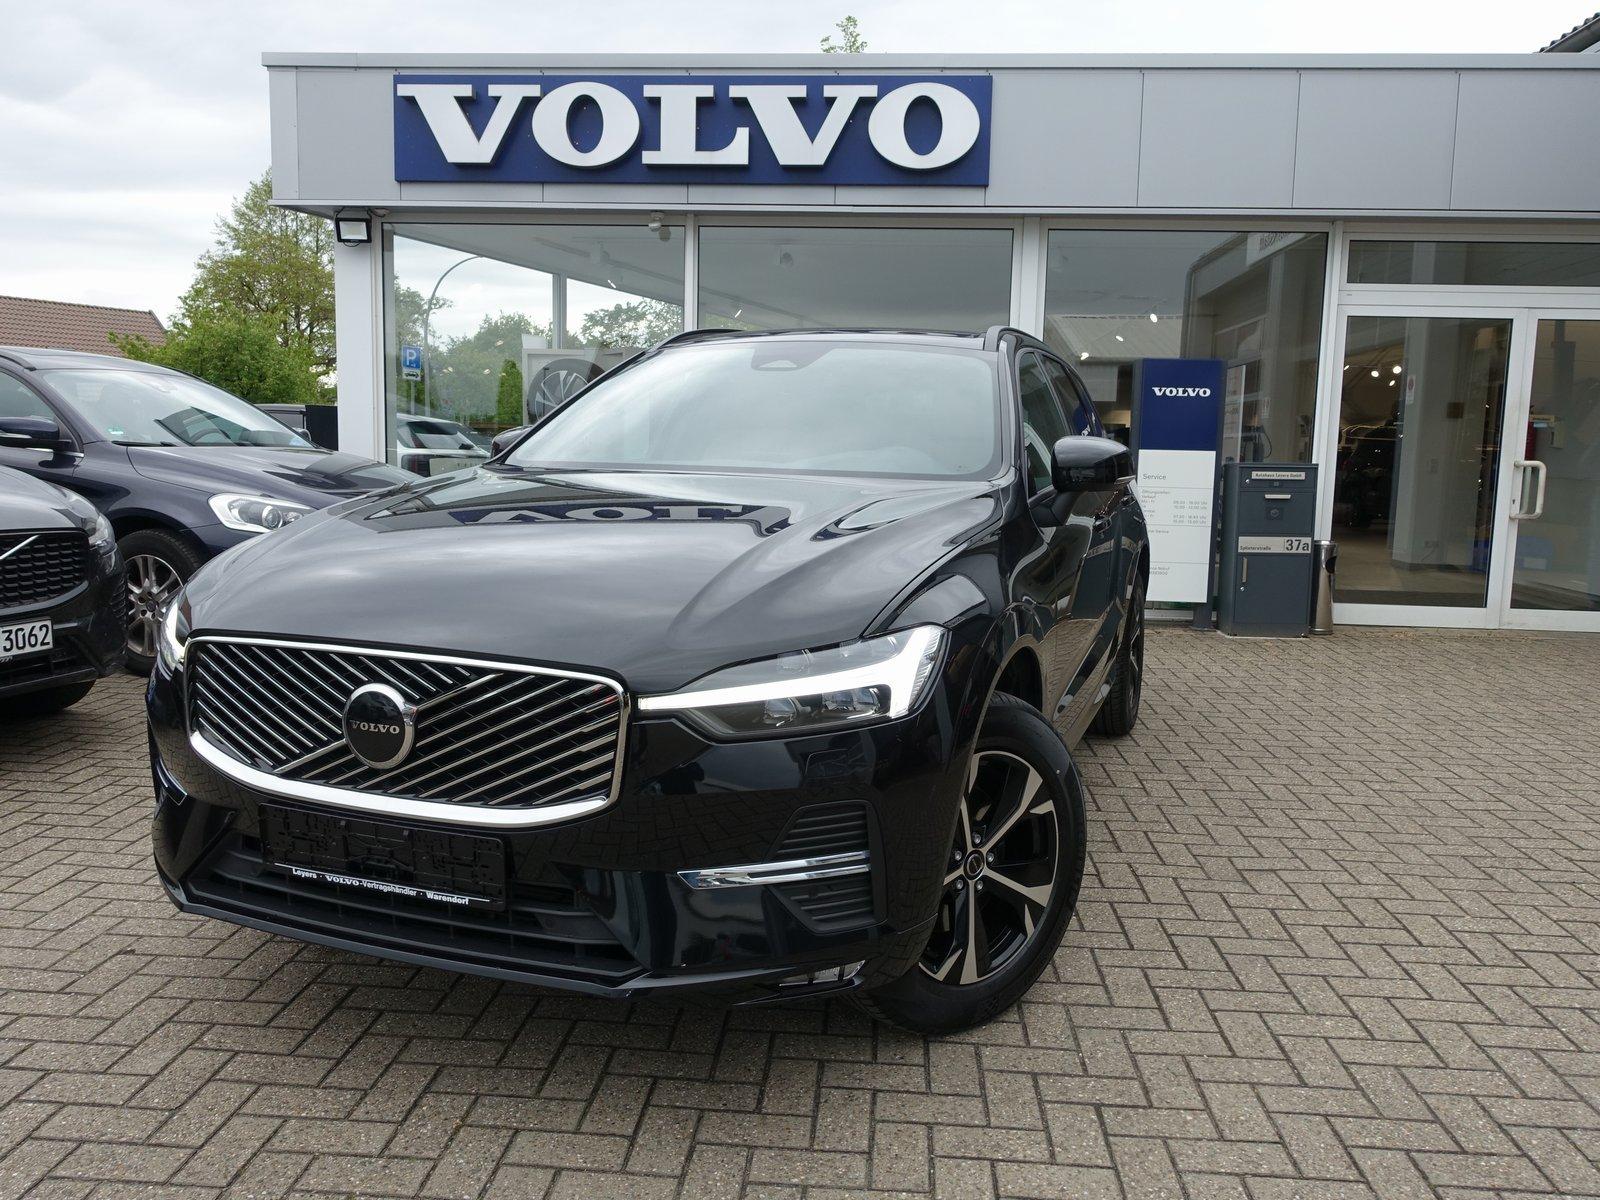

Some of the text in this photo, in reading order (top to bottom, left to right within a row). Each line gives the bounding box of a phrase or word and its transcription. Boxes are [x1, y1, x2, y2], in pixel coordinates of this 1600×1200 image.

[396, 81, 981, 169] VOLVO
[406, 349, 417, 366] P
[1151, 386, 1212, 398] VOLVO
[1142, 472, 1167, 480] Service
[1285, 538, 1310, 552] 37a
[1, 623, 51, 652] 3062
[349, 719, 400, 734] VOLVO
[292, 868, 318, 879] Leyers
[425, 891, 469, 905] Warendorf
